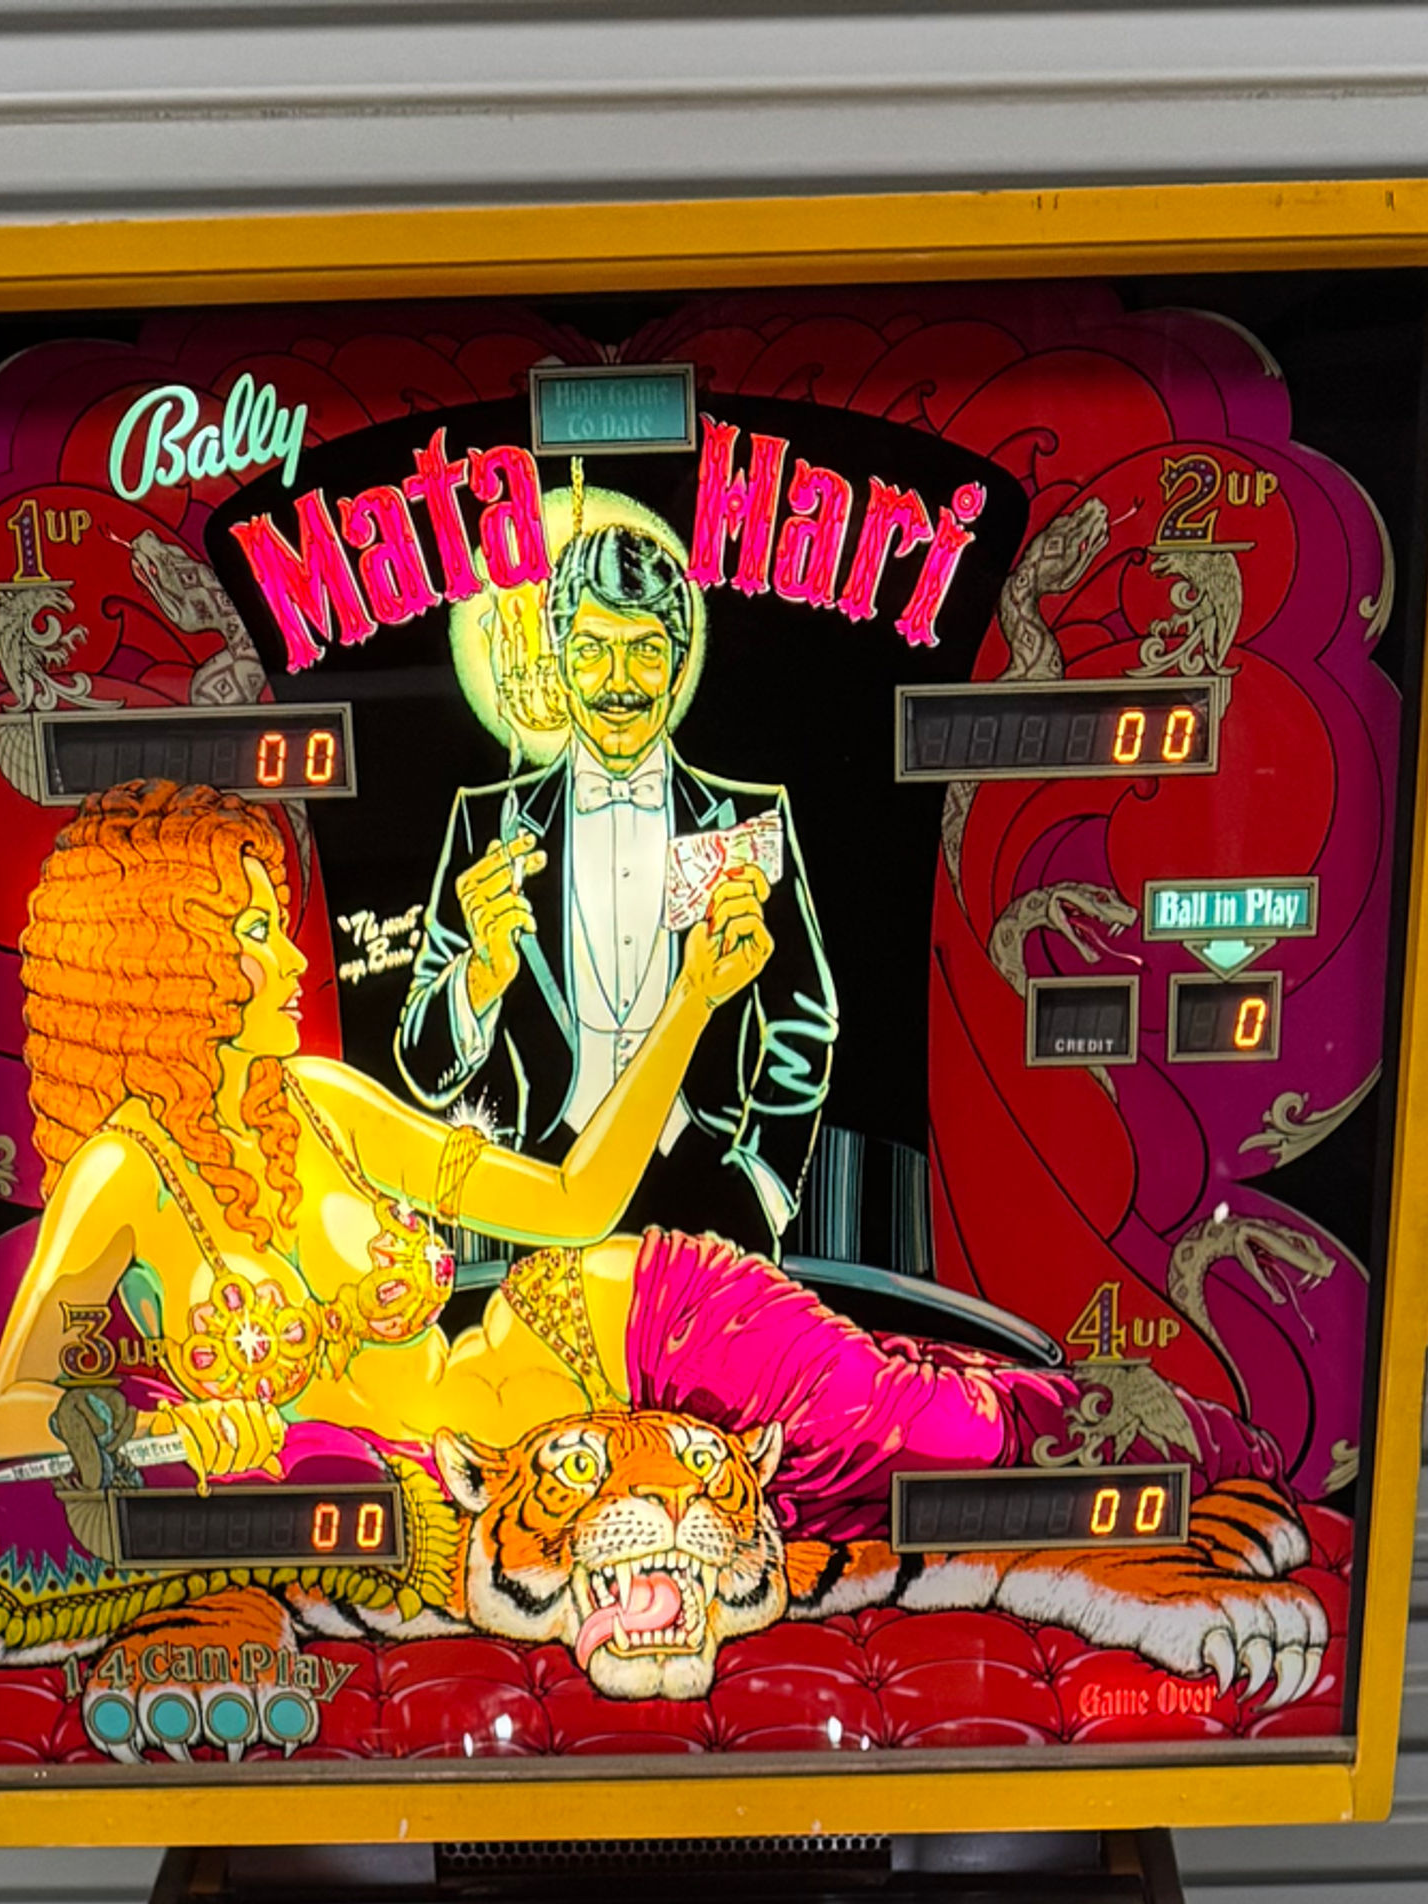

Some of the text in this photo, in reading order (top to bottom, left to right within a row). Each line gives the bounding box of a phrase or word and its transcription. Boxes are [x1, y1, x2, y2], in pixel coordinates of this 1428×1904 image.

[108, 372, 308, 501] Bally
[228, 411, 988, 676] Mata Hari
[1159, 888, 1300, 928] Ball in Play
[1055, 1040, 1114, 1053] CREDIT
[1234, 998, 1267, 1047] 0
[140, 1642, 230, 1684] Can
[240, 1642, 358, 1702] Play
[1080, 1681, 1216, 1720] Game Over
